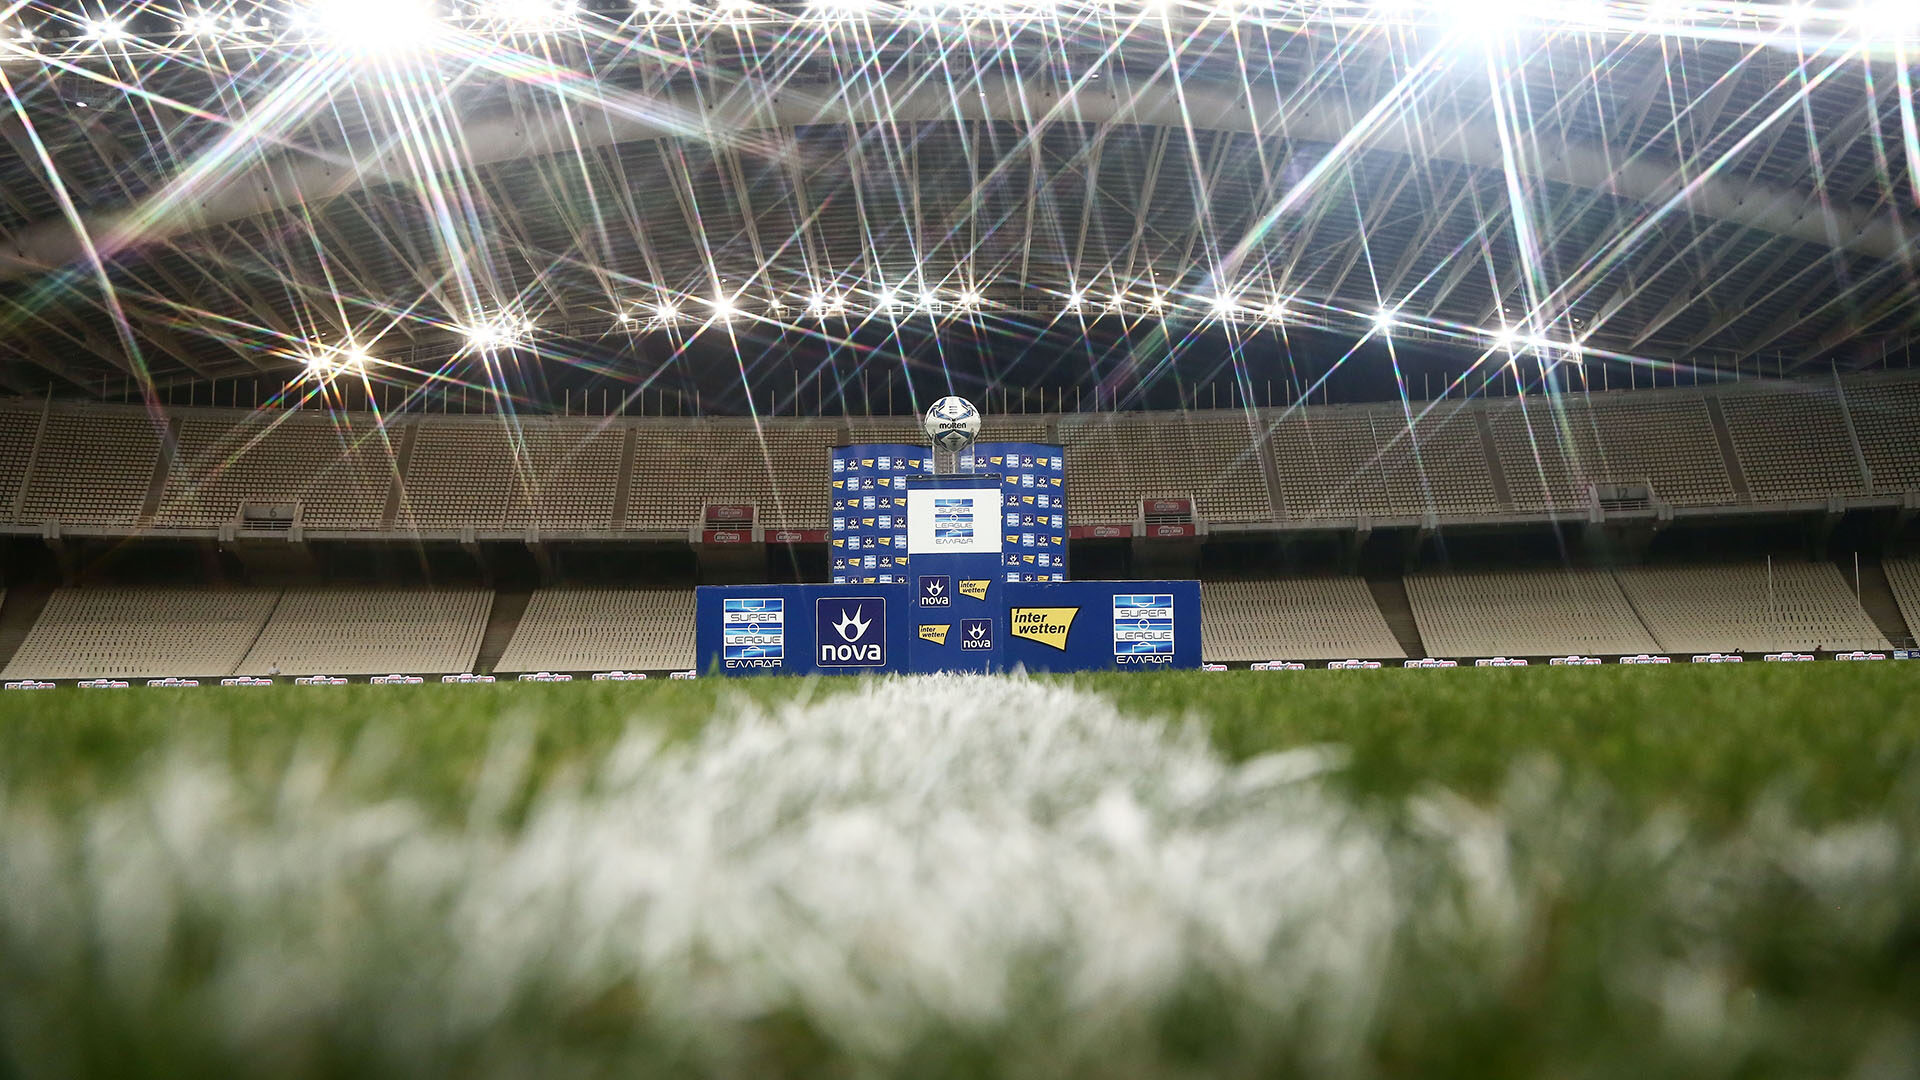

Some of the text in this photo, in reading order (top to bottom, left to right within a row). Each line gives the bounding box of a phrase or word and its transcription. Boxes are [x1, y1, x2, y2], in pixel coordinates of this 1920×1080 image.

[269, 508, 277, 518] 6
[960, 580, 976, 588] inter
[921, 596, 949, 605] nova
[730, 613, 777, 622] SUPER
[1014, 608, 1047, 623] inter
[1120, 609, 1167, 618] SUPER
[1019, 623, 1066, 634] wetten
[725, 635, 781, 644] LEAGUE
[1115, 631, 1172, 640] LEAGUE
[963, 639, 991, 649] nova
[821, 644, 881, 661] nova
